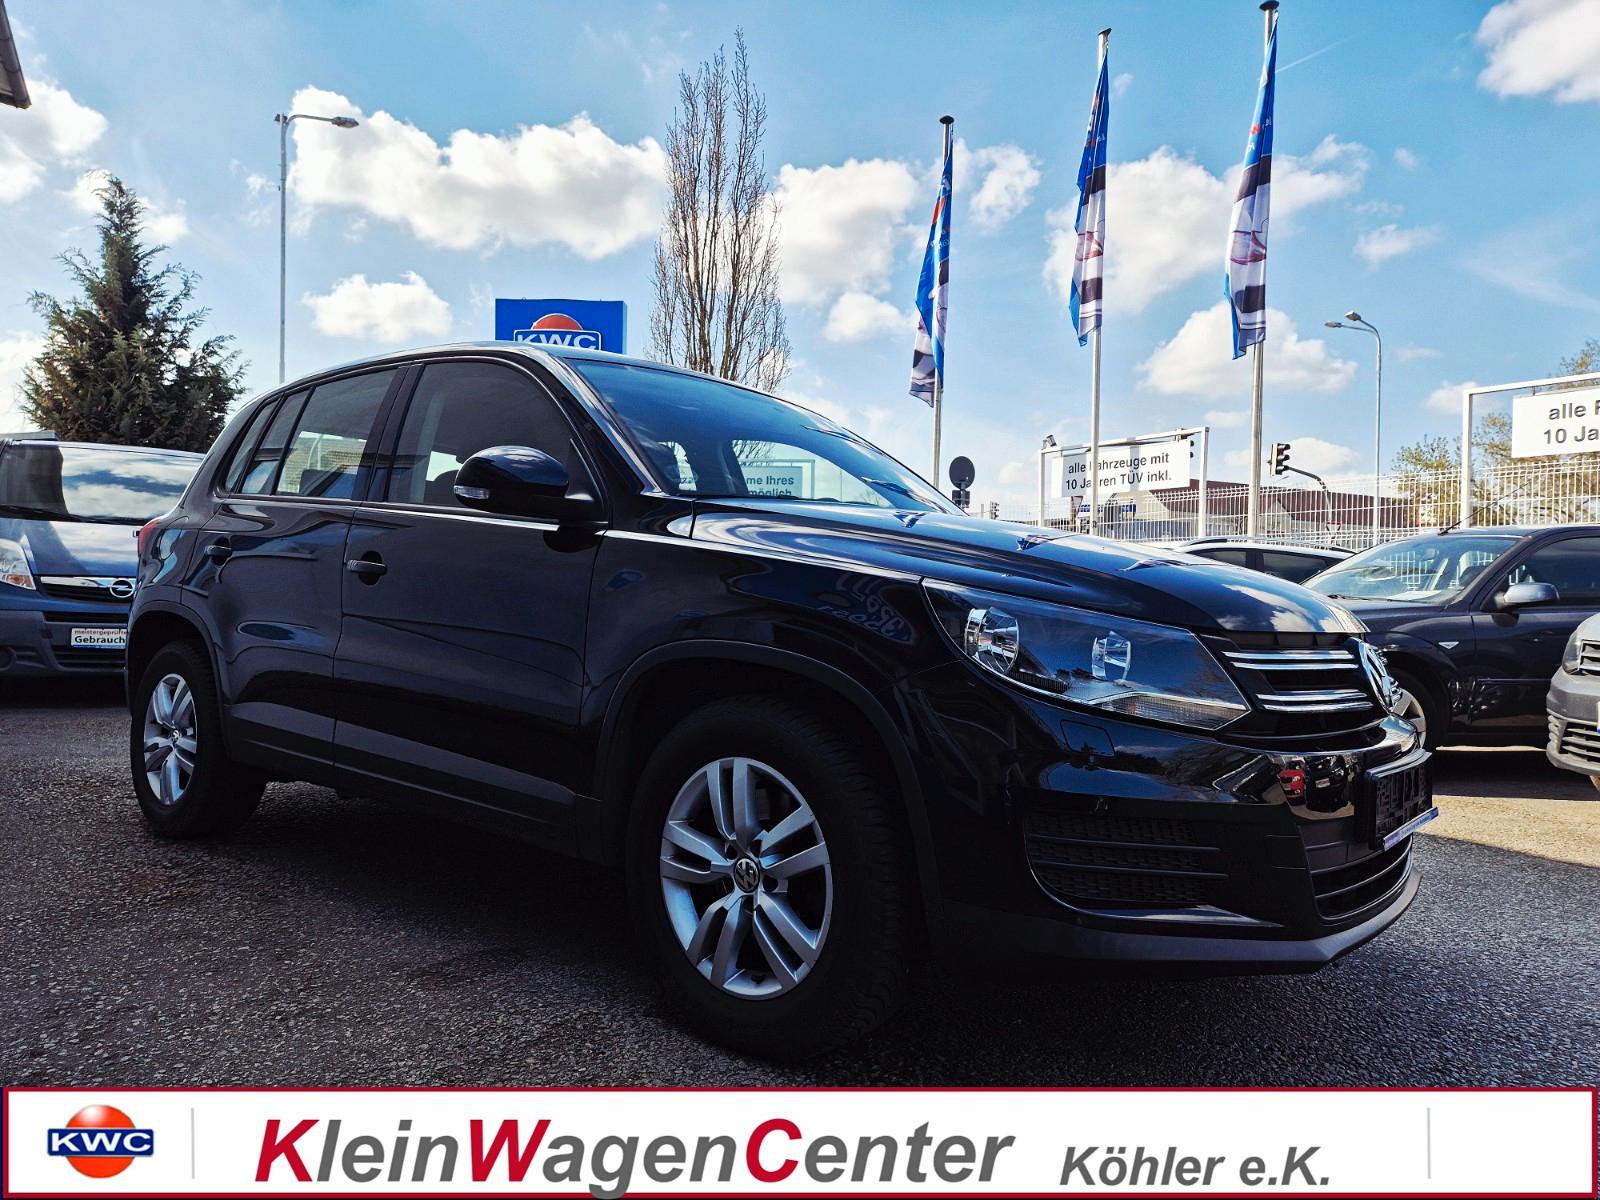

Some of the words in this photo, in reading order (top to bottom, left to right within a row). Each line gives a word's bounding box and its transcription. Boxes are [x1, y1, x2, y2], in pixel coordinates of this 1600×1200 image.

[1548, 402, 1587, 420] alle
[1543, 428, 1567, 444] 10
[1068, 462, 1087, 474] alle
[1089, 456, 1147, 471] ahrzeuge
[1150, 452, 1169, 464] mit
[766, 475, 795, 485] Ihres
[1065, 478, 1078, 490] 10
[1080, 477, 1116, 488] Jaren
[1120, 470, 1143, 484] TÜV
[1147, 469, 1172, 482] inkl.
[74, 635, 126, 644] Gebrauch
